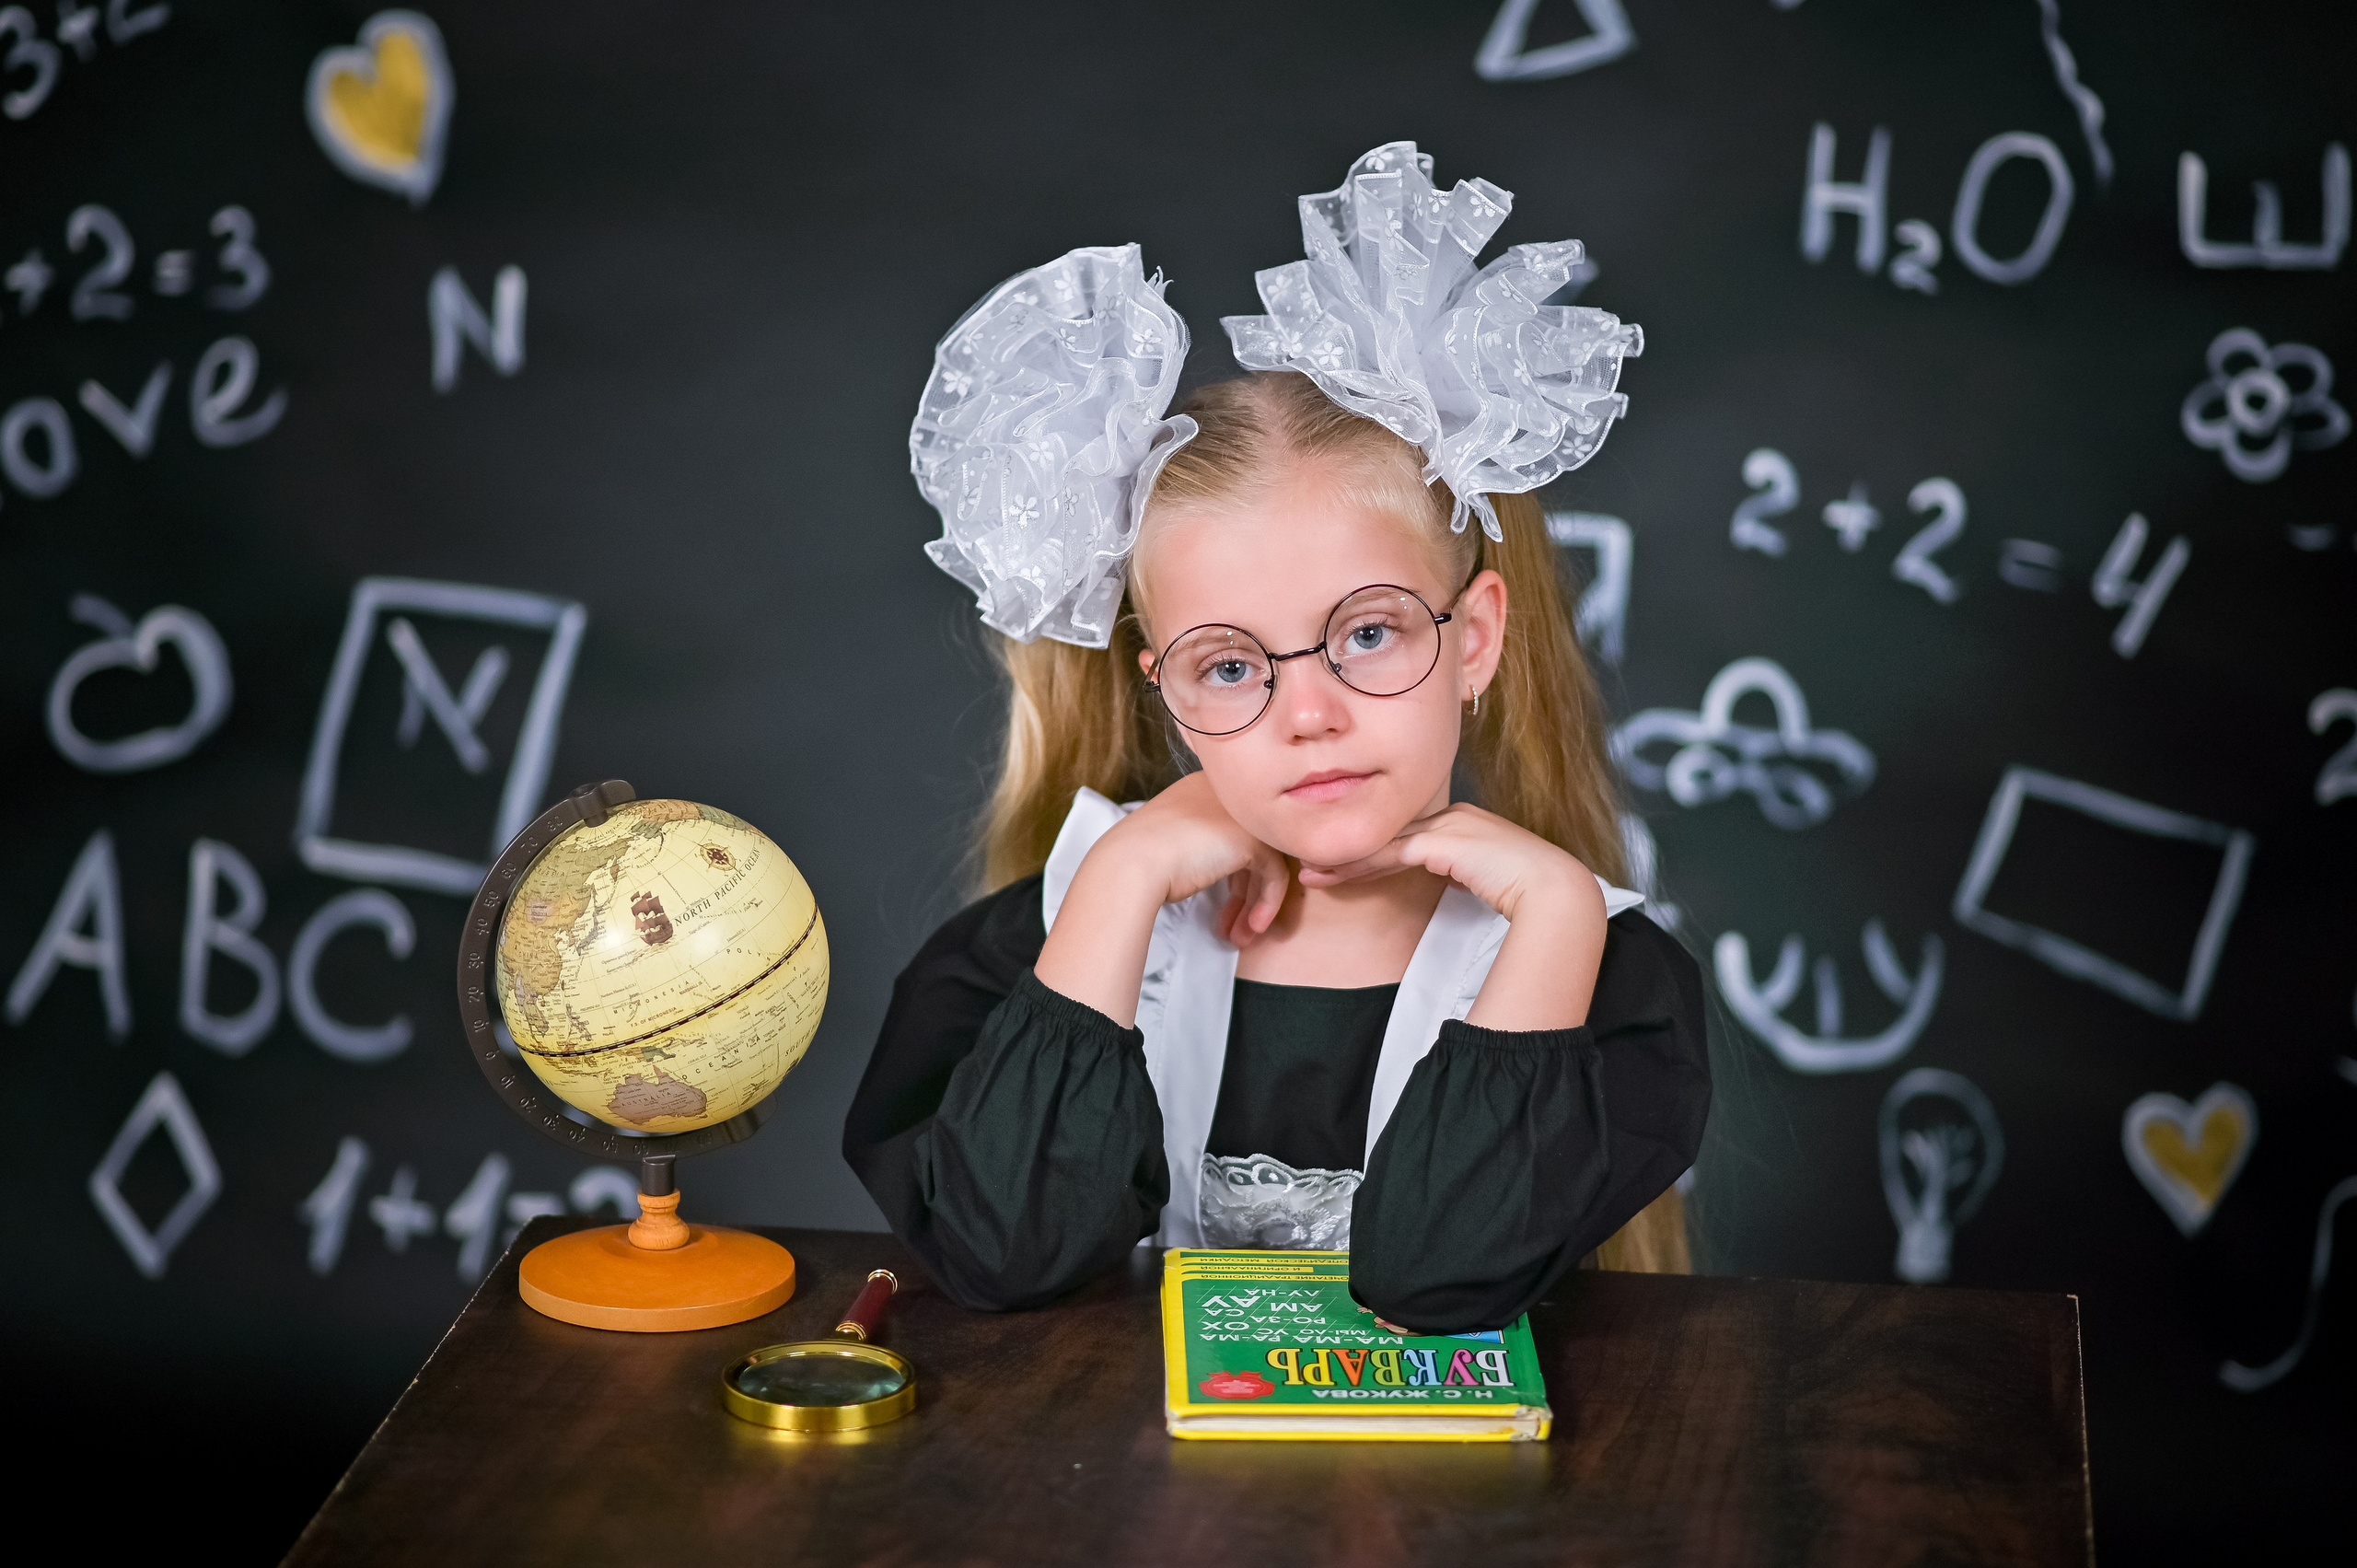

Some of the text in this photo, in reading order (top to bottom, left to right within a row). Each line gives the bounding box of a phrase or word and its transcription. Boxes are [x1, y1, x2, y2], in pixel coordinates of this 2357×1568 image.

[427, 264, 528, 394] N
[0, 334, 289, 500] ove
[675, 899, 712, 926] NORTH
[714, 869, 746, 900] PACIFIC
[744, 848, 761, 871] OCEAN
[647, 1006, 677, 1021] MICRONESIA
[622, 1092, 671, 1106] AUSTRALIA
[1201, 1295, 1261, 1307] АУ
[1203, 1308, 1245, 1317] СА
[1271, 1303, 1323, 1312] АМ
[1202, 1321, 1250, 1330] ОХ
[1250, 1316, 1326, 1324] РО-ЗА
[1200, 1334, 1404, 1345] МА-МА РА-МА
[1265, 1347, 1515, 1388] БУКВАРЬ
[1311, 1388, 1433, 1400] ЖУКОВА
